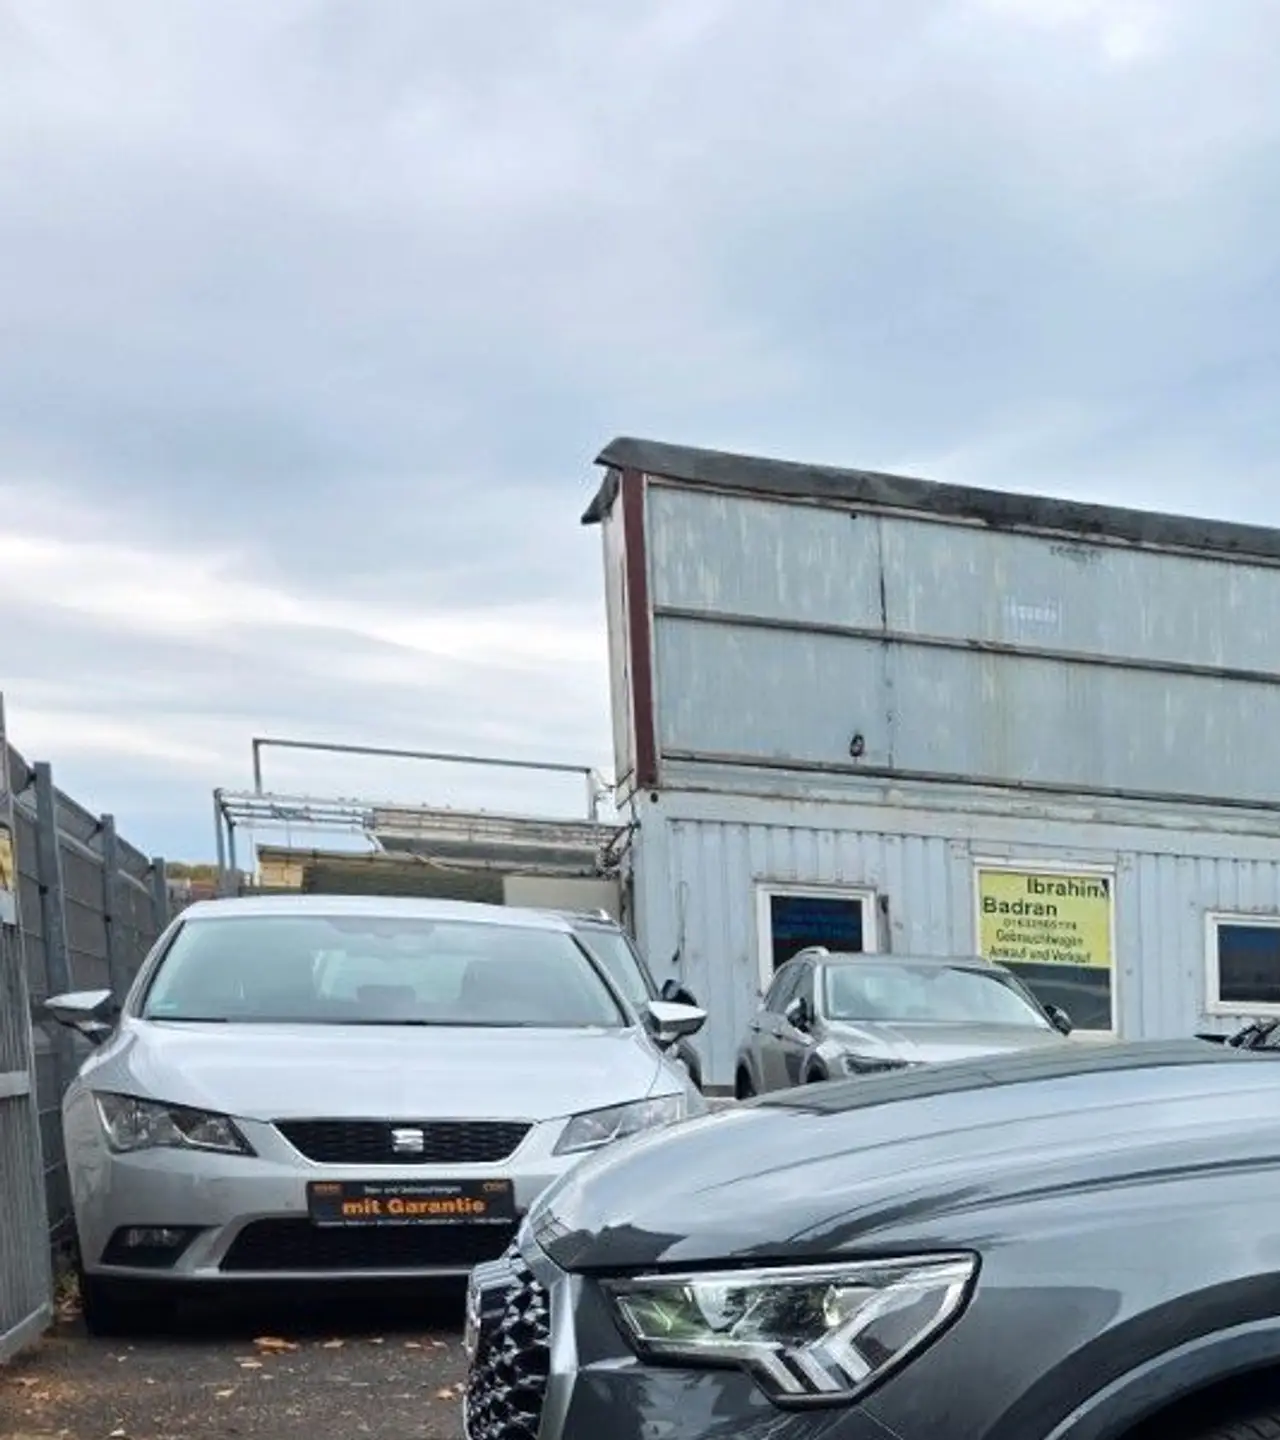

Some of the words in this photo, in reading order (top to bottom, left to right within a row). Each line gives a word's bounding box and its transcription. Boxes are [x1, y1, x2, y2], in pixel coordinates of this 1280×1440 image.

[983, 896, 1057, 916] Badran
[342, 1198, 382, 1215] mit
[387, 1197, 486, 1214] Garantie
